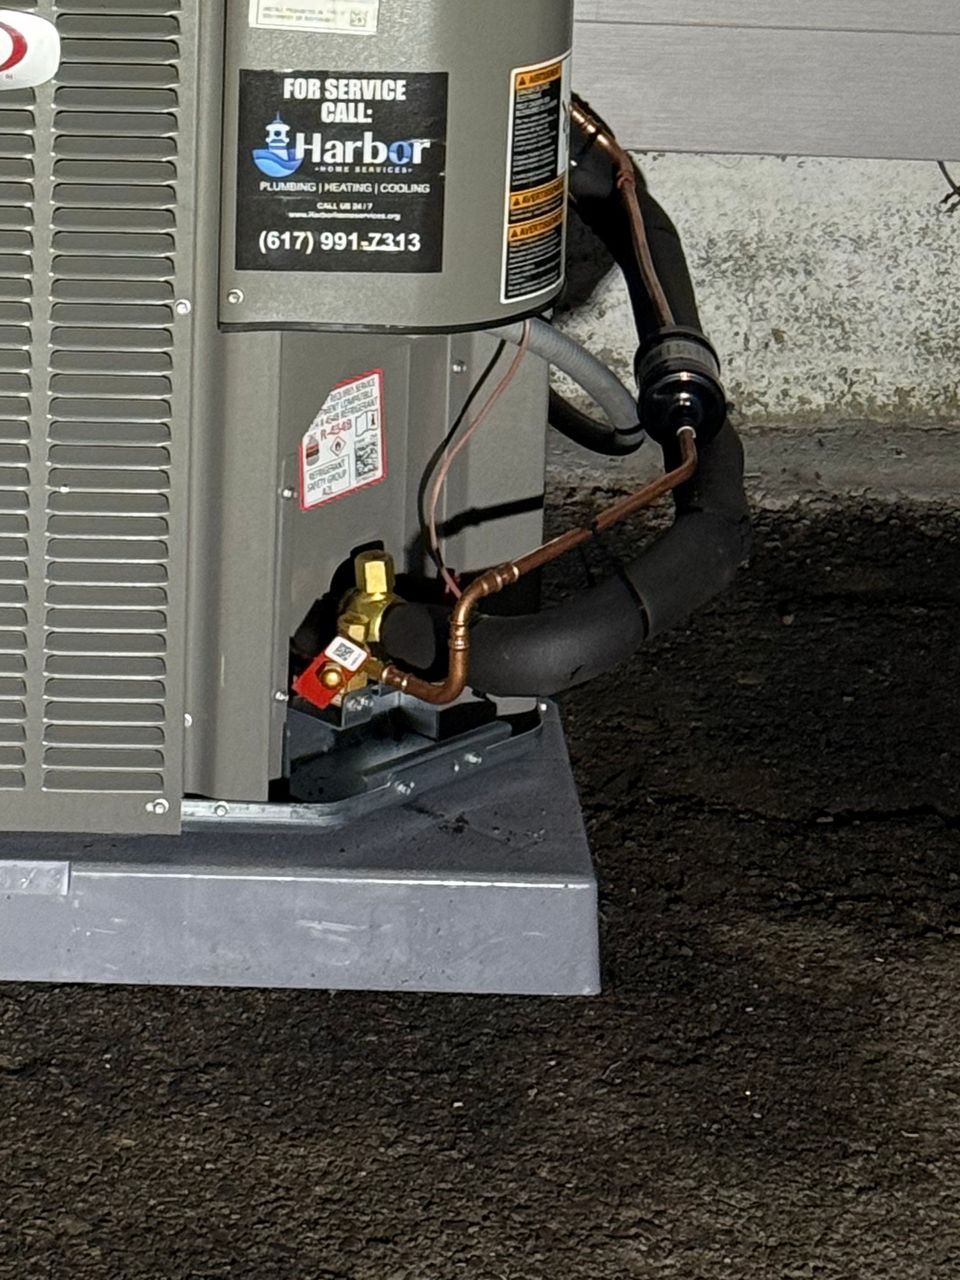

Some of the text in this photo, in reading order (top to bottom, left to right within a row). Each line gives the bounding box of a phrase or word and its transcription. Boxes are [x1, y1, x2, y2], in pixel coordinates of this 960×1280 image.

[283, 78, 407, 100] FOR SERVICE
[321, 102, 373, 124] CALL:
[295, 131, 431, 165] Harbor
[319, 166, 408, 174] HOME SERVICES
[259, 181, 431, 194] PLUMBING HEATING COOLING
[316, 202, 338, 210] CALL
[339, 202, 351, 210] US
[259, 230, 422, 255] (617) 991-7313
